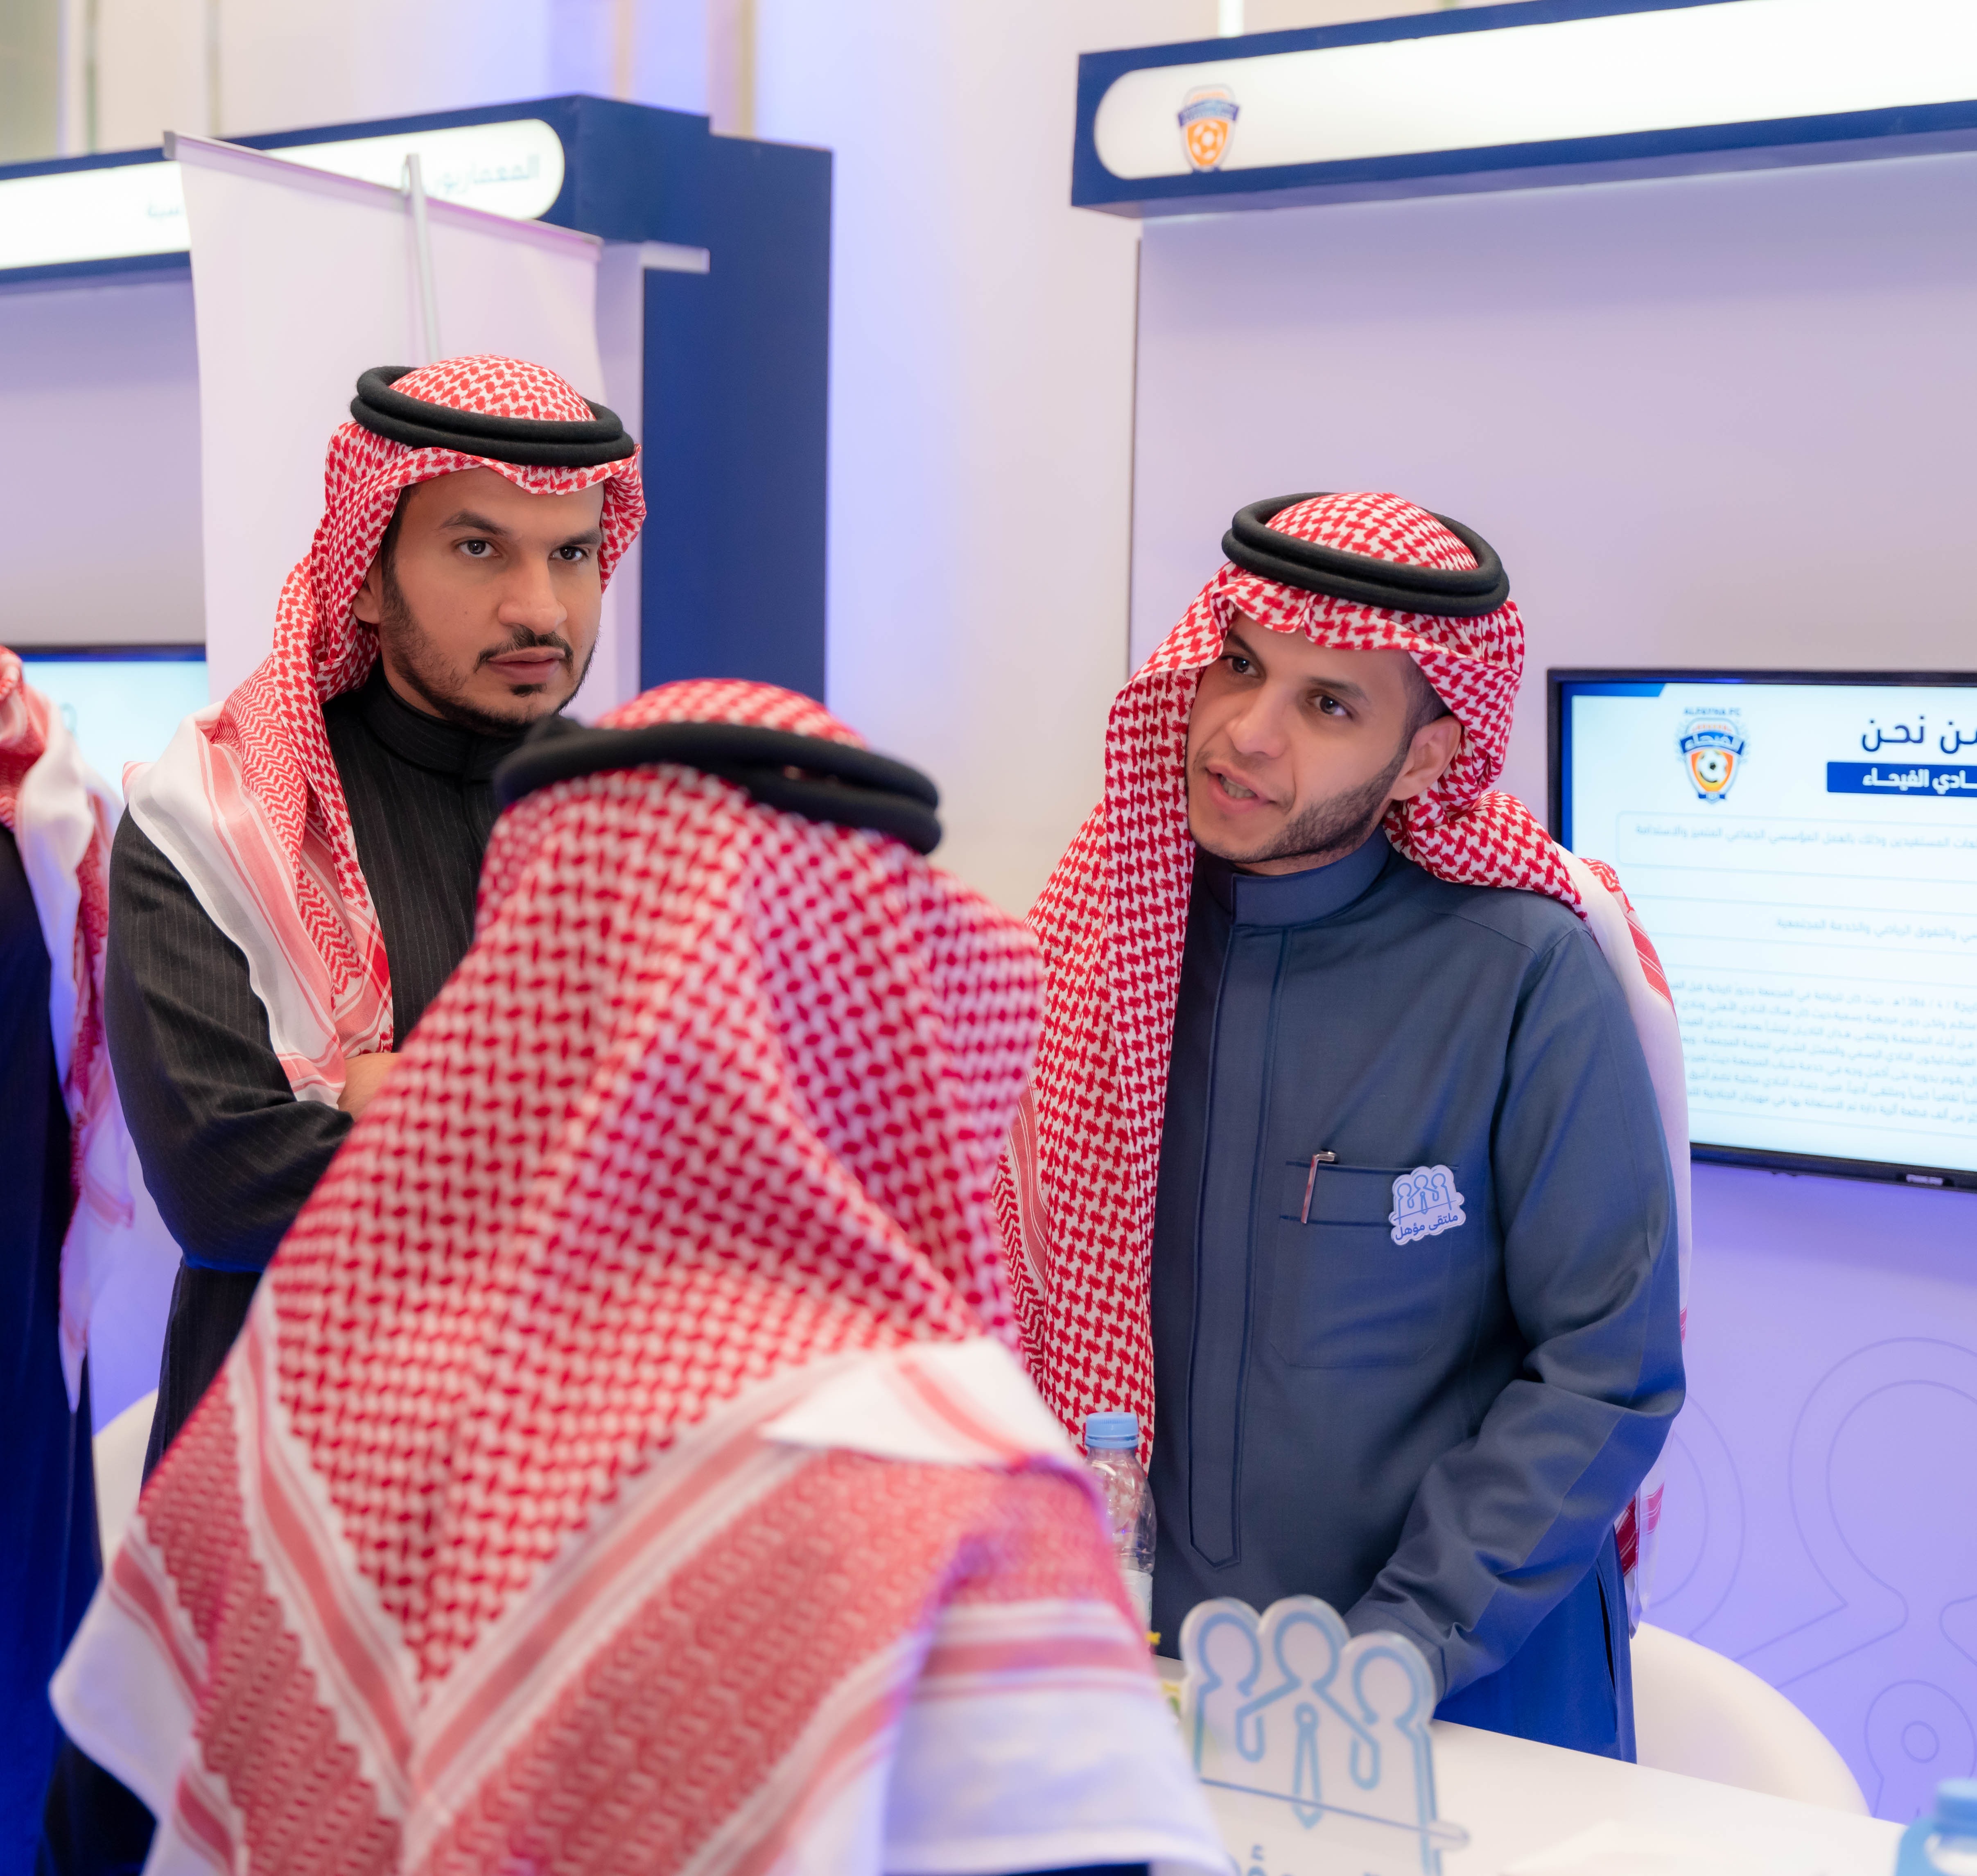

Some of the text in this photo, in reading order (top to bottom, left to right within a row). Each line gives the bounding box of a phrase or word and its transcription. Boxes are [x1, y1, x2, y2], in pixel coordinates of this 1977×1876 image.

[1862, 715, 1925, 752] نحن
[1862, 766, 1930, 791] الفيحاء
[1395, 1213, 1459, 1240] ملتقى مؤهل
